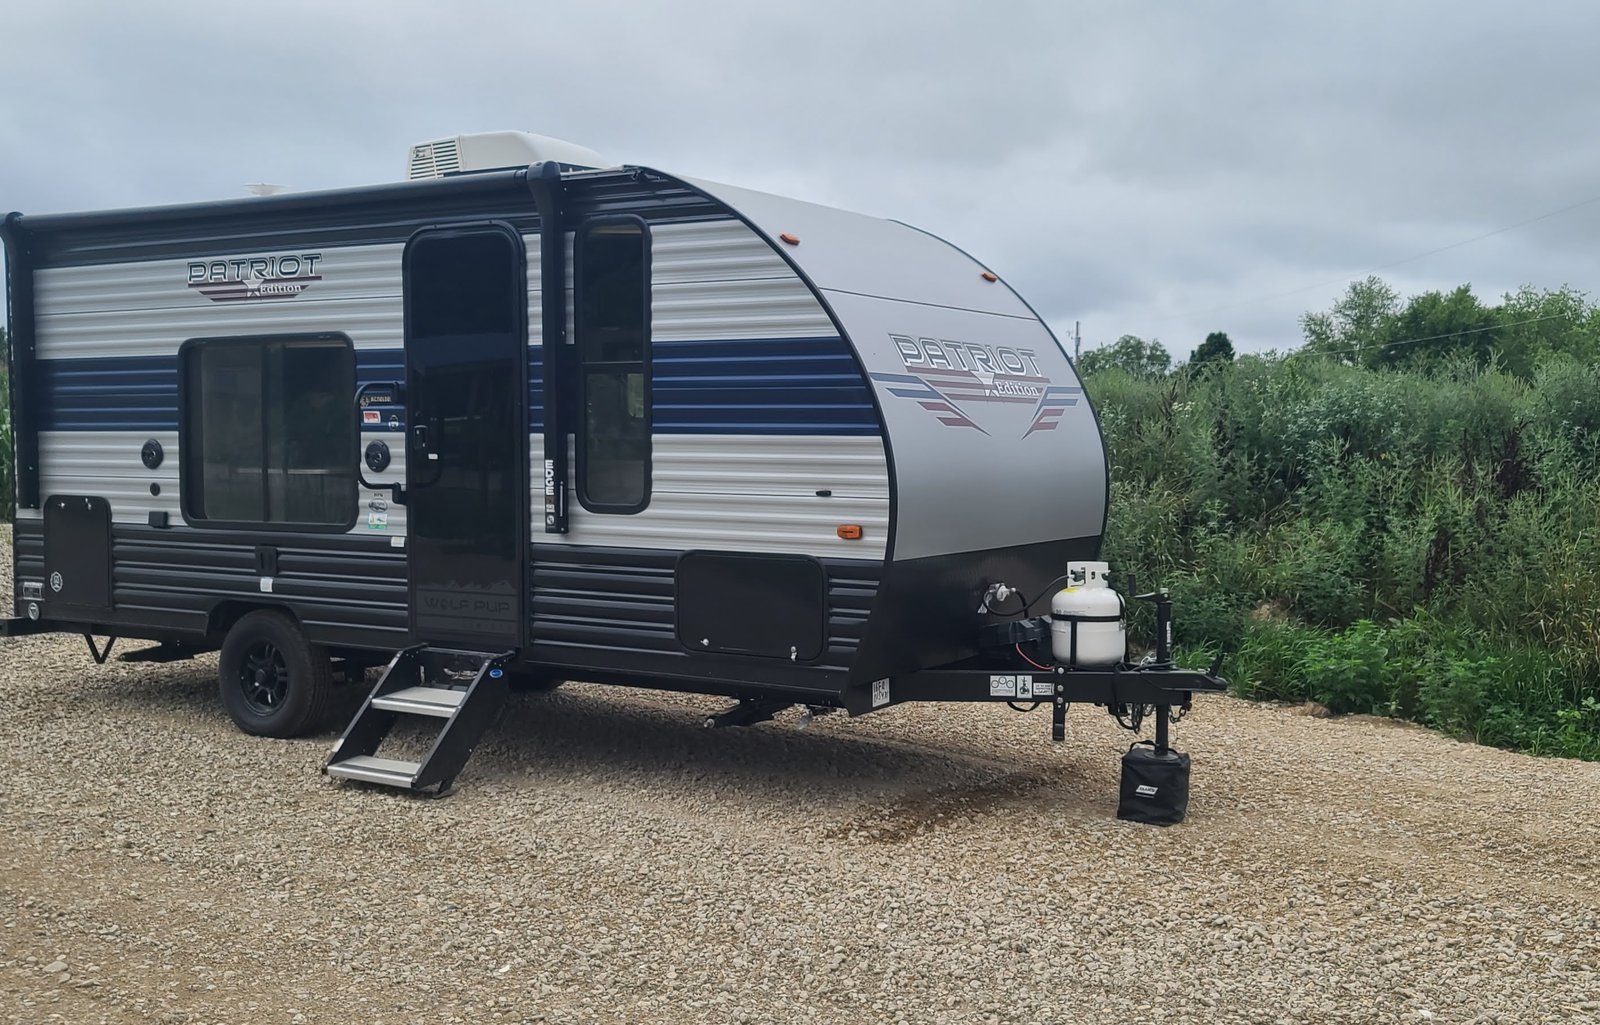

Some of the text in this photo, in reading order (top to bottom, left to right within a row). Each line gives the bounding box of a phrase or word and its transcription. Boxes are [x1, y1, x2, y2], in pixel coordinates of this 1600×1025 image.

[187, 253, 322, 283] PATRIOT
[260, 284, 302, 294] Edition
[888, 333, 1042, 377] PATRIOT
[995, 381, 1040, 396] Edition
[545, 460, 555, 496] EDGE
[425, 597, 511, 613] WOLF PUP
